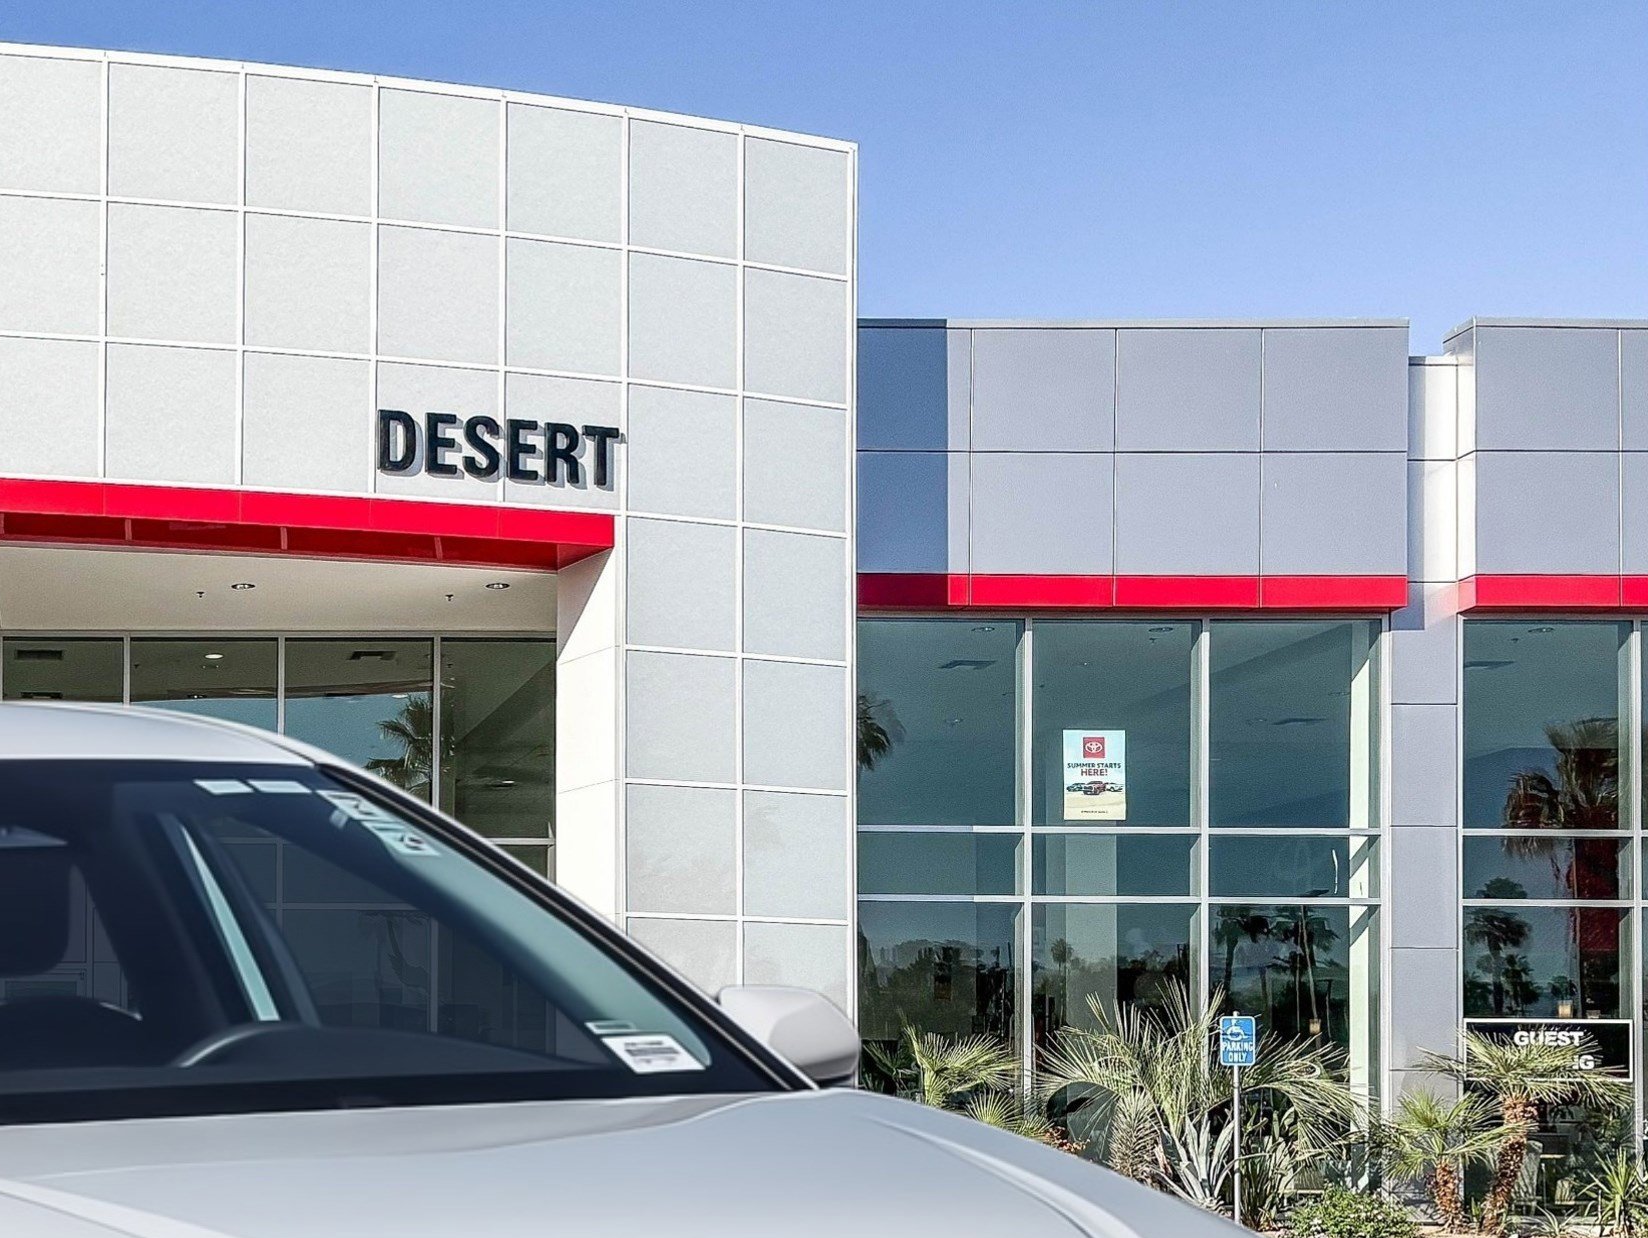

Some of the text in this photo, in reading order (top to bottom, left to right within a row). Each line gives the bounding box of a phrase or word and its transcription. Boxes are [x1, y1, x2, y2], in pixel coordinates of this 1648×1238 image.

[376, 409, 620, 487] DESERT
[1080, 768, 1108, 776] HERE!
[1513, 1031, 1584, 1047] GUEST
[1222, 1041, 1254, 1052] PARKING
[1228, 1051, 1248, 1063] ONLY
